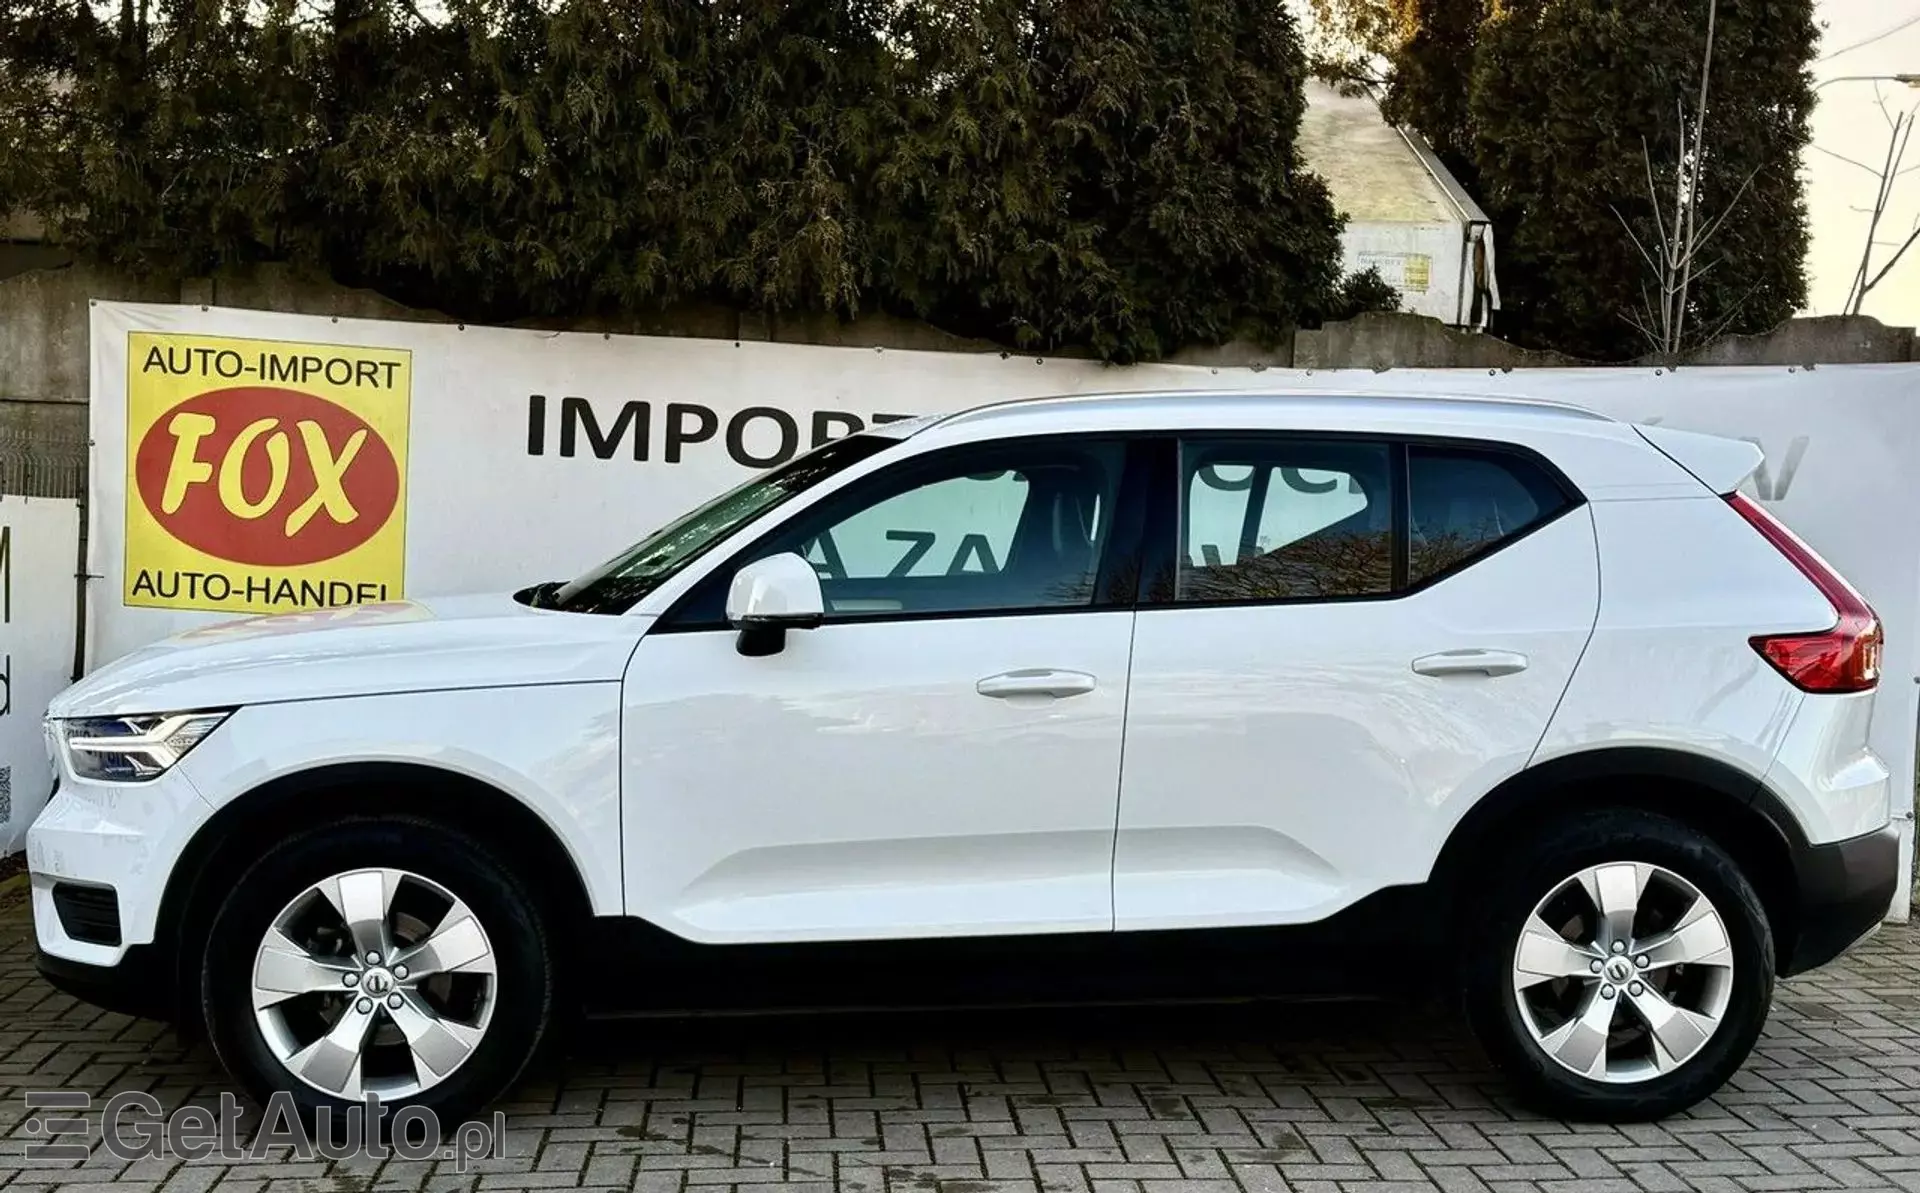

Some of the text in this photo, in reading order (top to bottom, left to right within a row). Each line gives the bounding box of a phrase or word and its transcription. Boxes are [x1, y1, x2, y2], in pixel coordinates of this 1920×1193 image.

[142, 345, 401, 389] AUTO-IMPORT
[527, 395, 919, 469] IMPOR
[160, 411, 369, 538] FOX
